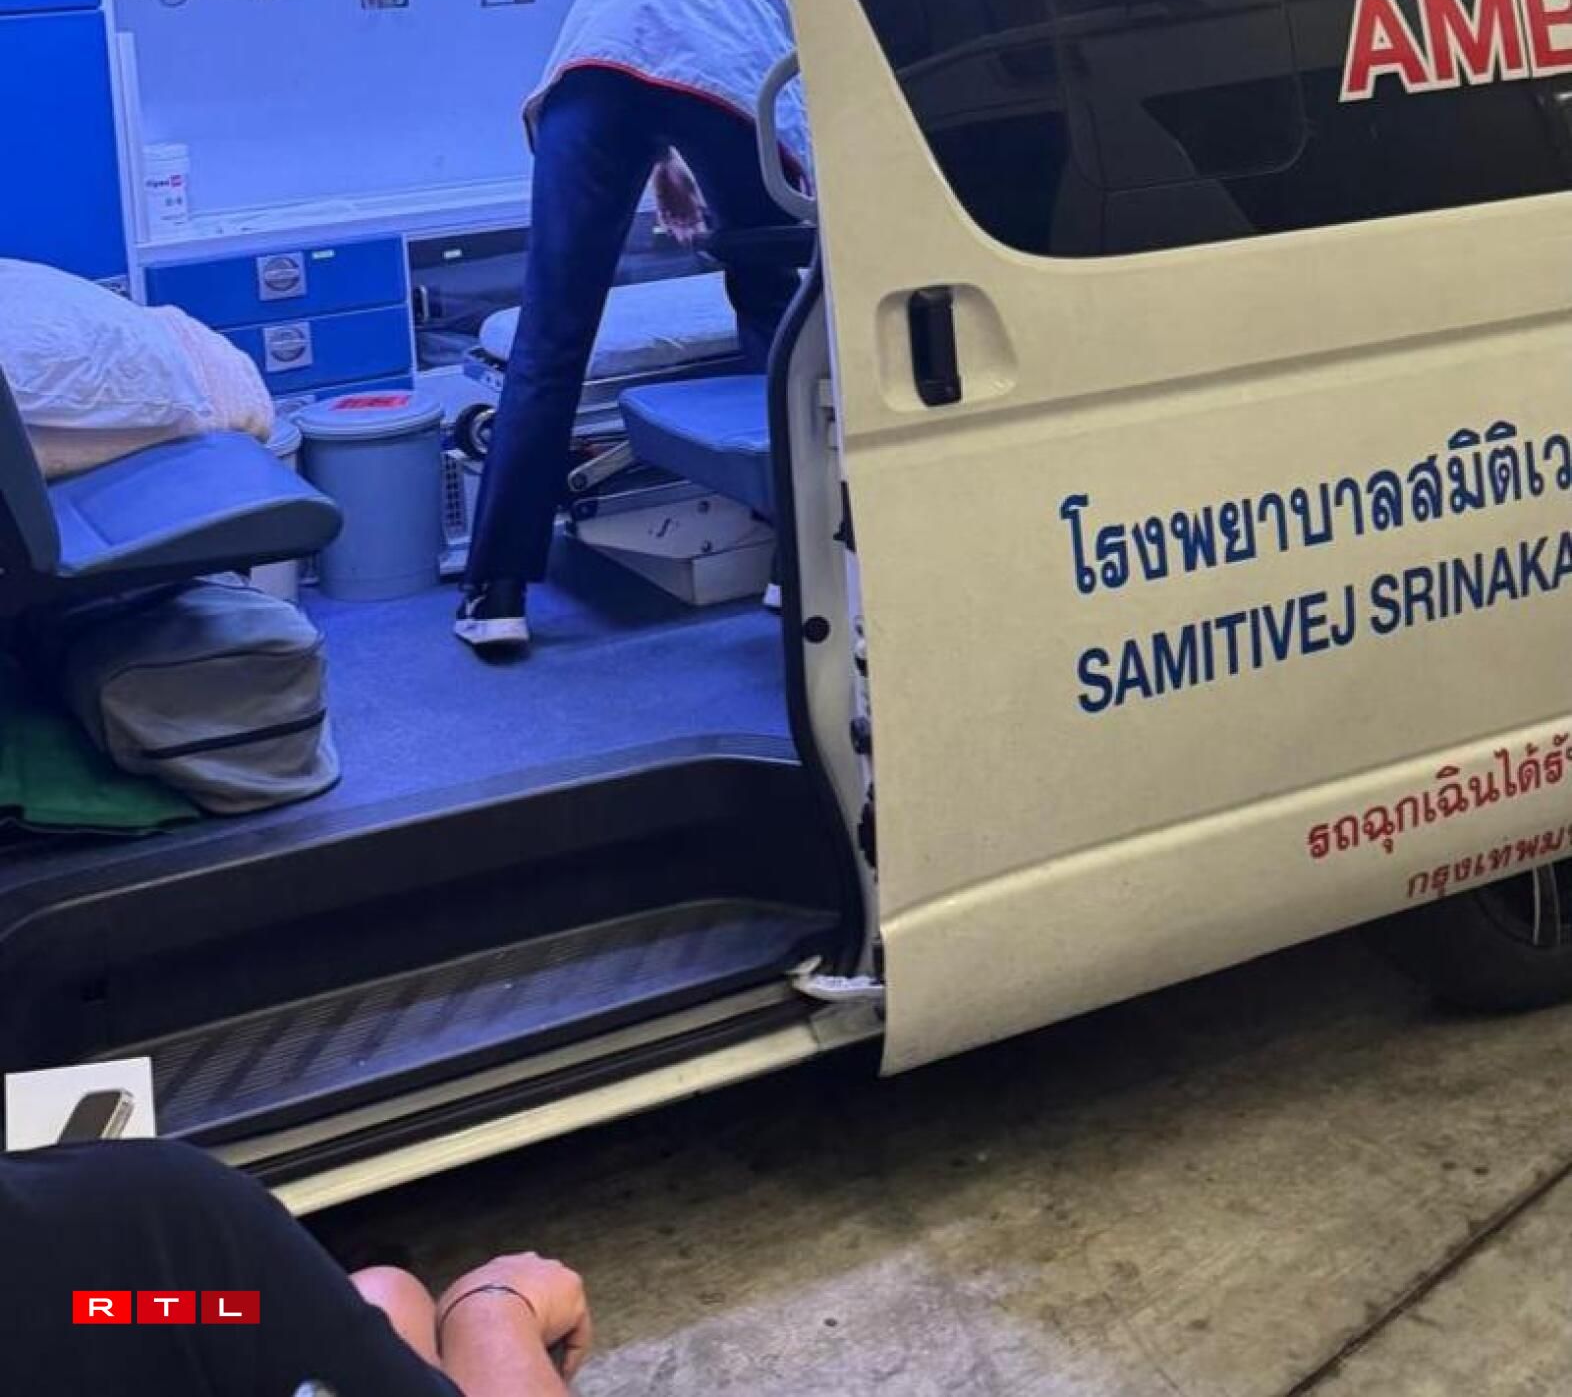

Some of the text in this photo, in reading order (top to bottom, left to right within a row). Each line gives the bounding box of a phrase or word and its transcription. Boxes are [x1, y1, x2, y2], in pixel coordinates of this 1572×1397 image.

[1078, 585, 1356, 714] SAMITIVEJ
[1406, 825, 1572, 898] กรุงเทพม
